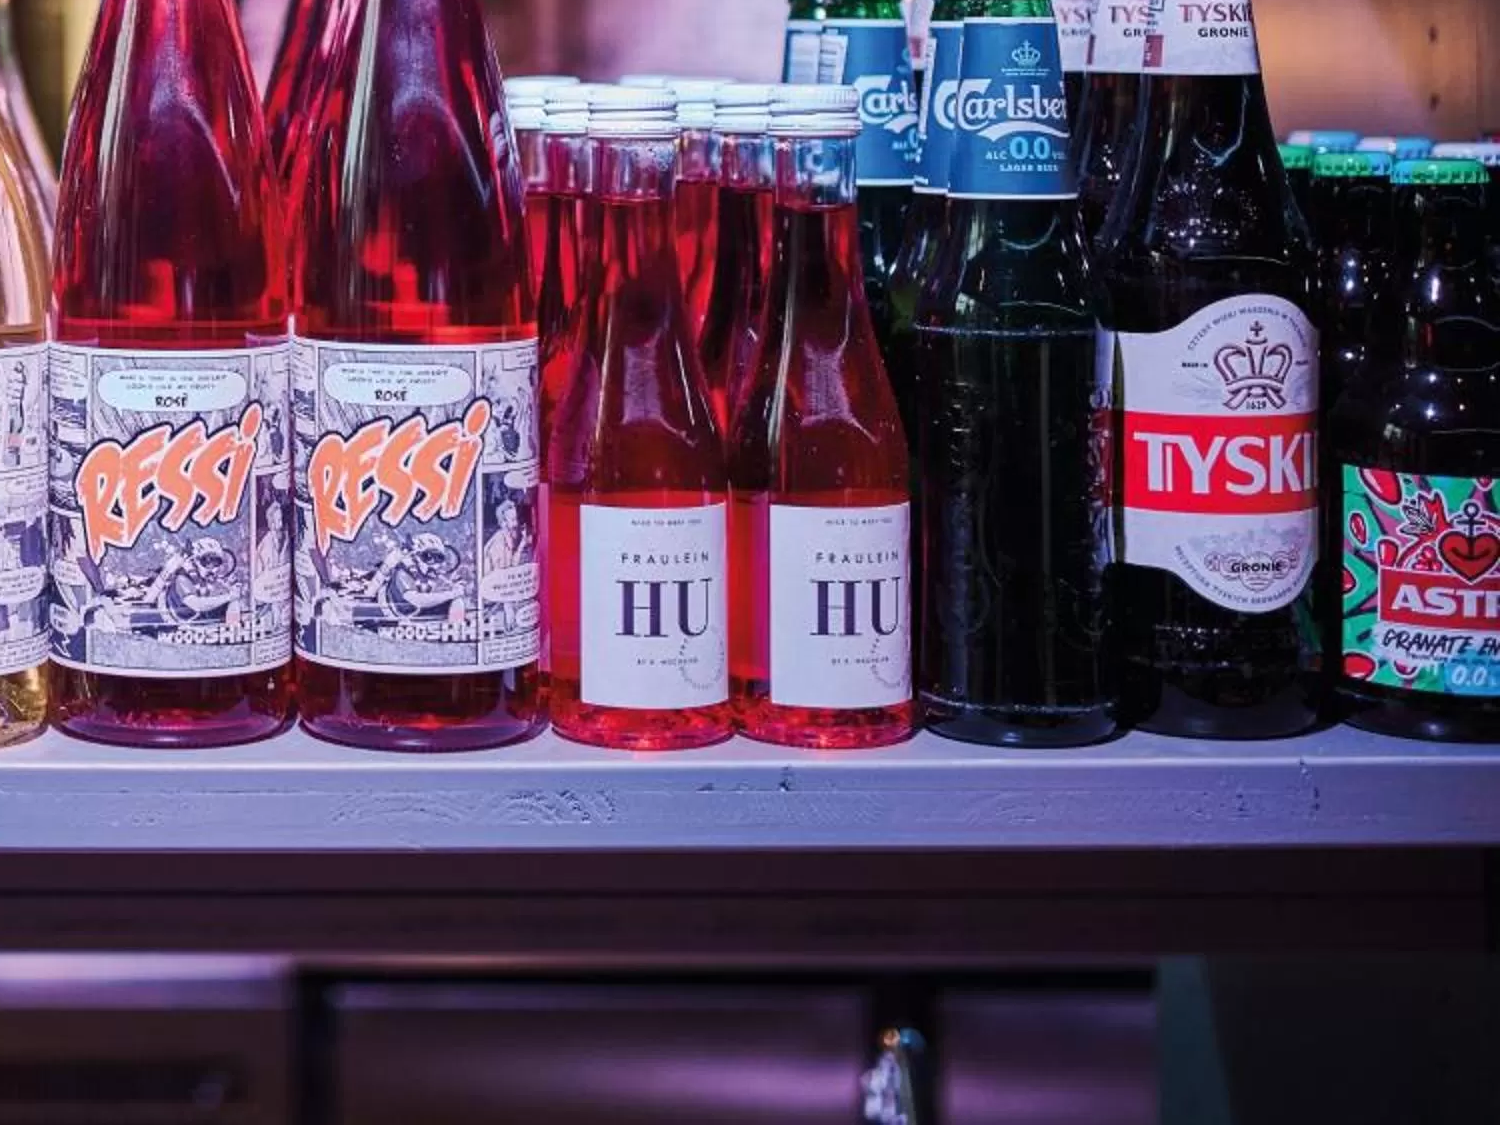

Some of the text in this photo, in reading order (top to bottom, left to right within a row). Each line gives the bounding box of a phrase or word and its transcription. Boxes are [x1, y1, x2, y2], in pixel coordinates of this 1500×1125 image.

[1108, 5, 1151, 24] TYS
[1197, 27, 1249, 39] GRONIE
[854, 75, 917, 125] Carls
[1010, 136, 1050, 160] 0.0
[615, 577, 713, 637] HU
[809, 576, 901, 636] HU
[1382, 628, 1473, 655] GRANATE
